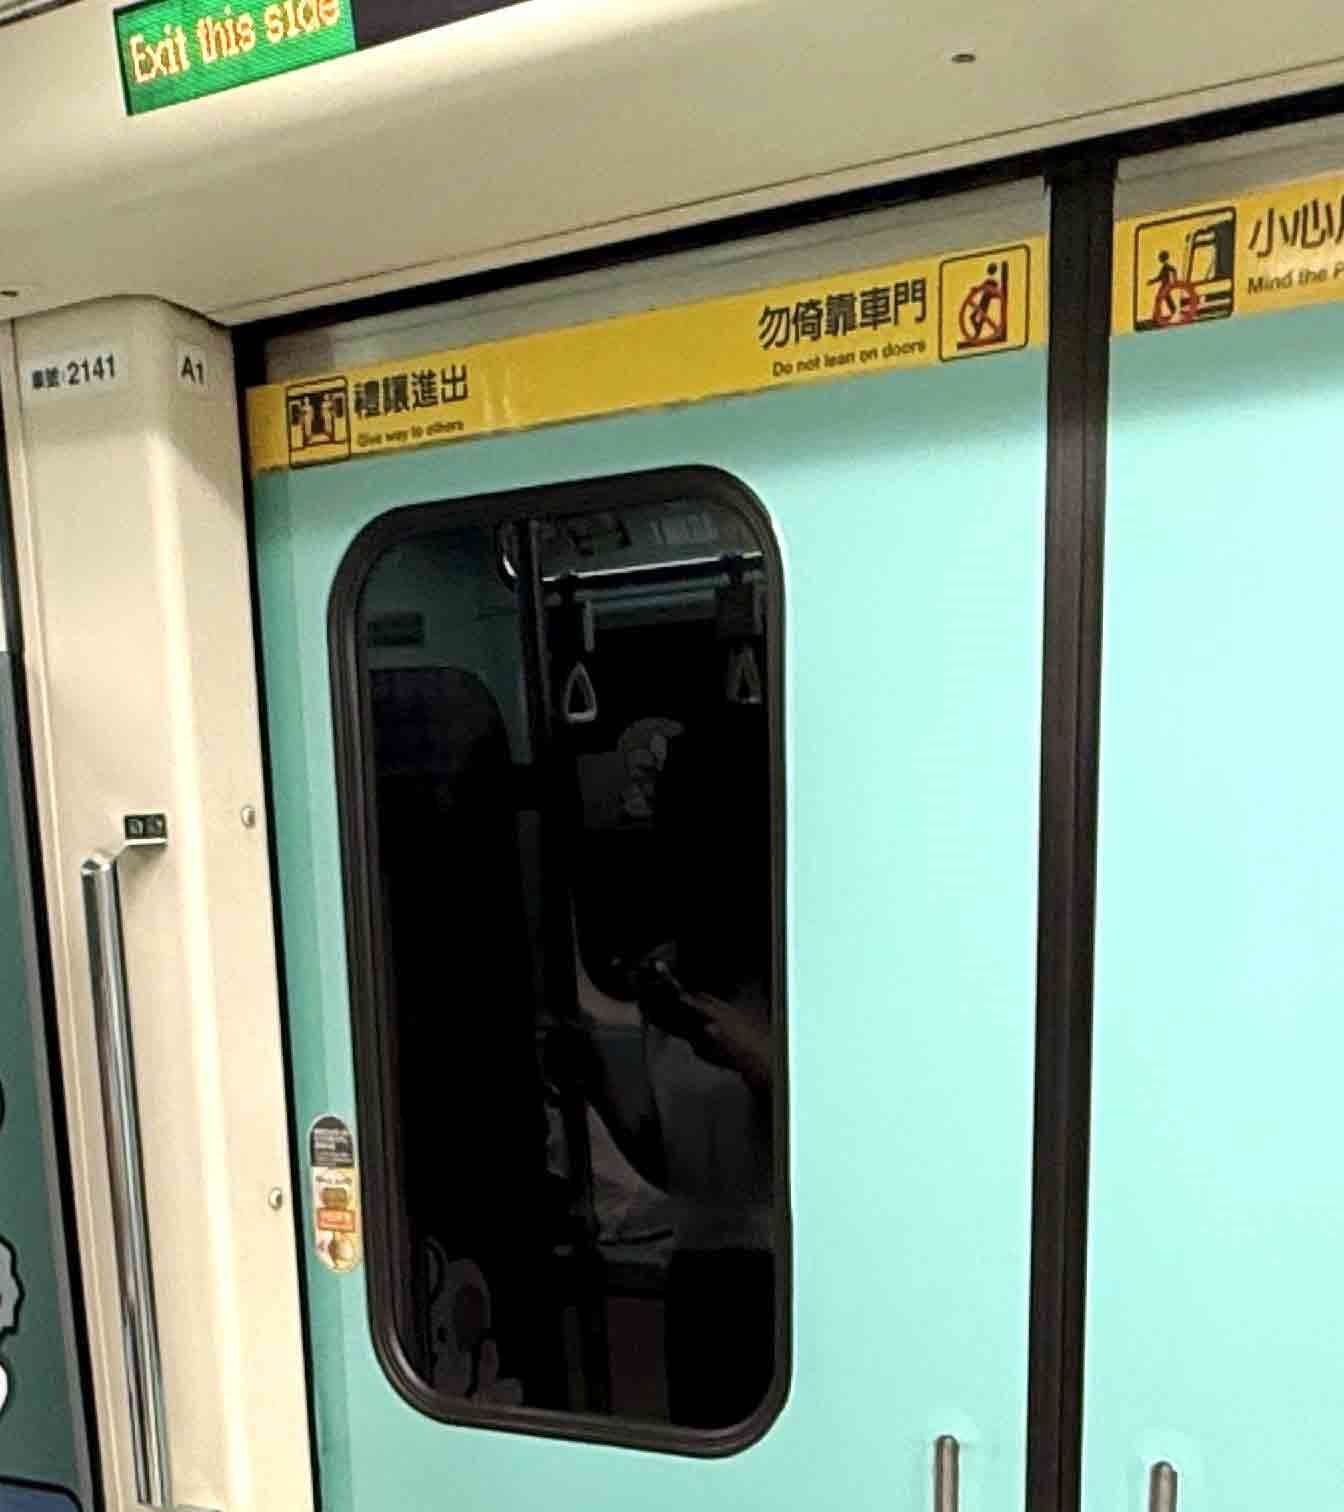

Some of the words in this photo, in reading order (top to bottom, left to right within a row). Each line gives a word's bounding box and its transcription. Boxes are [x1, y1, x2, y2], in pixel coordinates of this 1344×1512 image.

[129, 23, 190, 84] Exit
[196, 4, 257, 64] this
[263, 0, 342, 44] side
[1246, 271, 1294, 297] Mind
[1297, 265, 1329, 286] the
[757, 277, 927, 350] 勿倚靠車門
[66, 353, 116, 385] 2141
[180, 356, 205, 385] A1
[772, 360, 793, 378] Do
[796, 354, 821, 373] not
[824, 349, 856, 369] lean
[859, 347, 878, 363] on
[882, 338, 927, 360] doors
[353, 363, 469, 419] 禮讓進出
